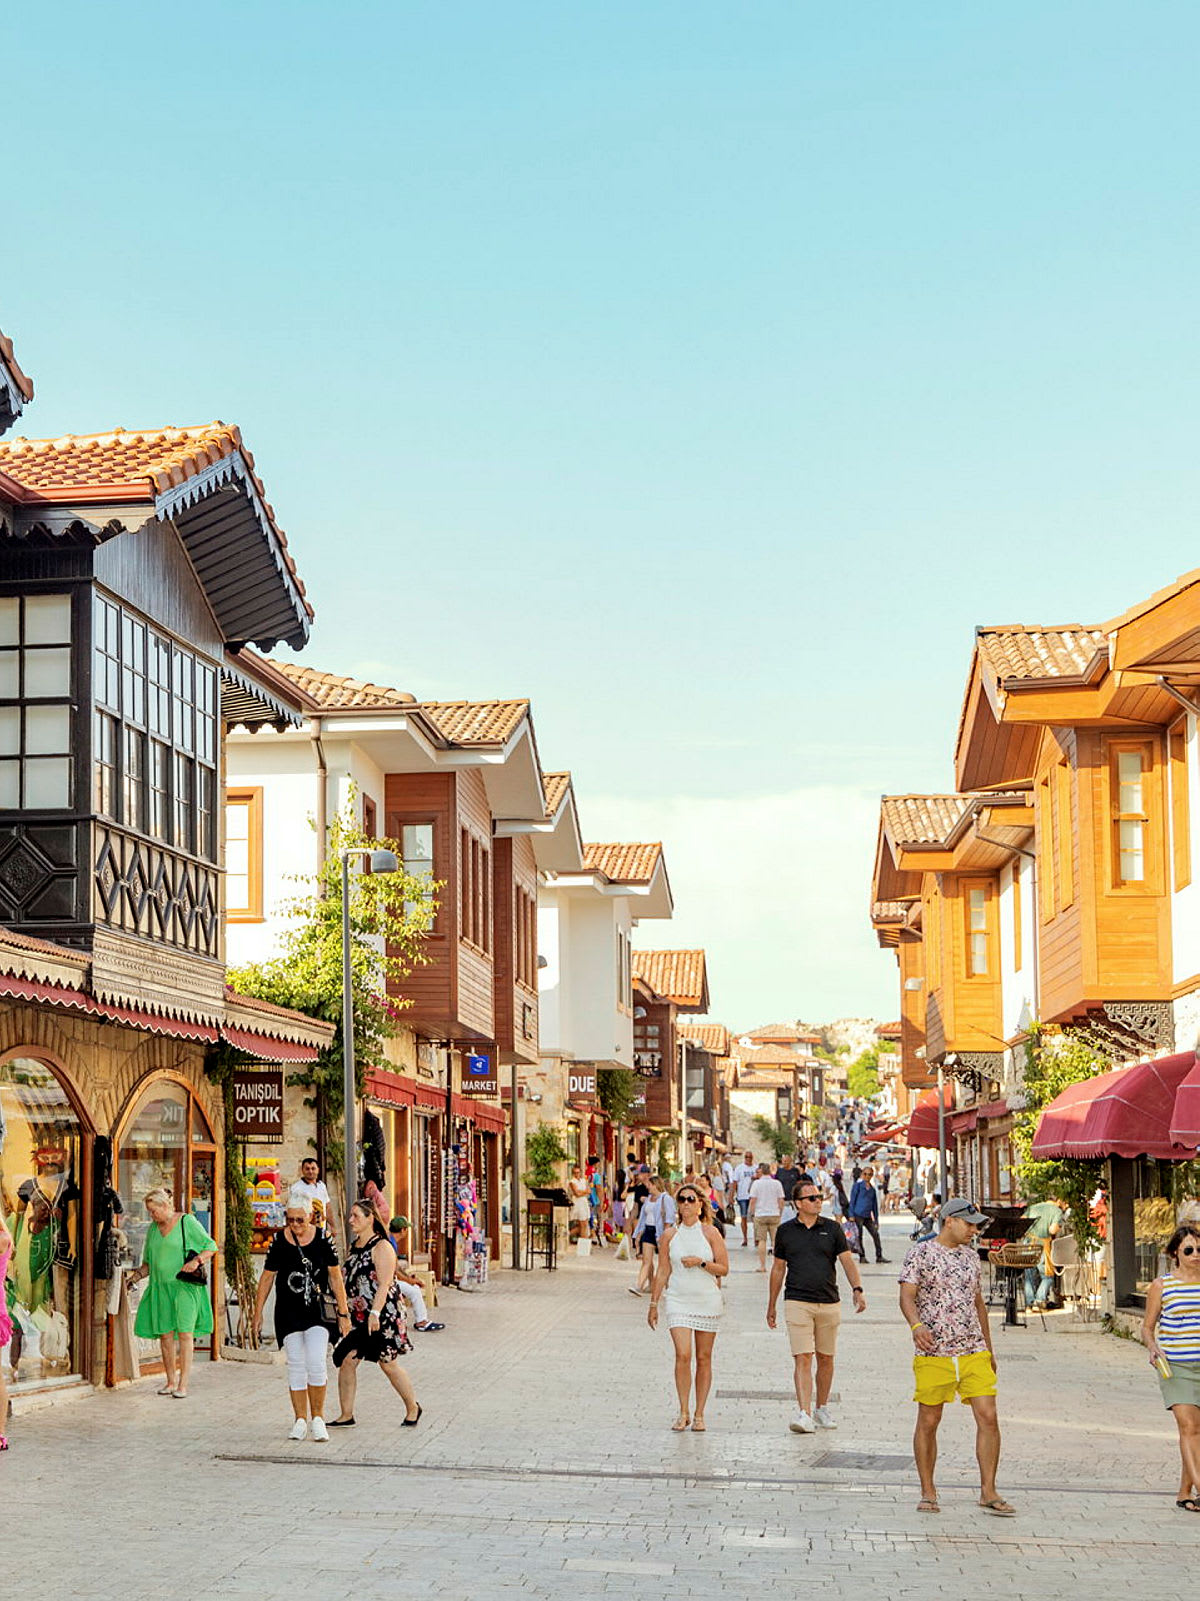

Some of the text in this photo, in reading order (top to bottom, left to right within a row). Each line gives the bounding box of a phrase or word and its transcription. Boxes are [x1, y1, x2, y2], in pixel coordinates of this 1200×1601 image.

[461, 1081, 497, 1091] MARKET
[569, 1076, 595, 1093] DUE
[235, 1106, 281, 1123] OPTIK
